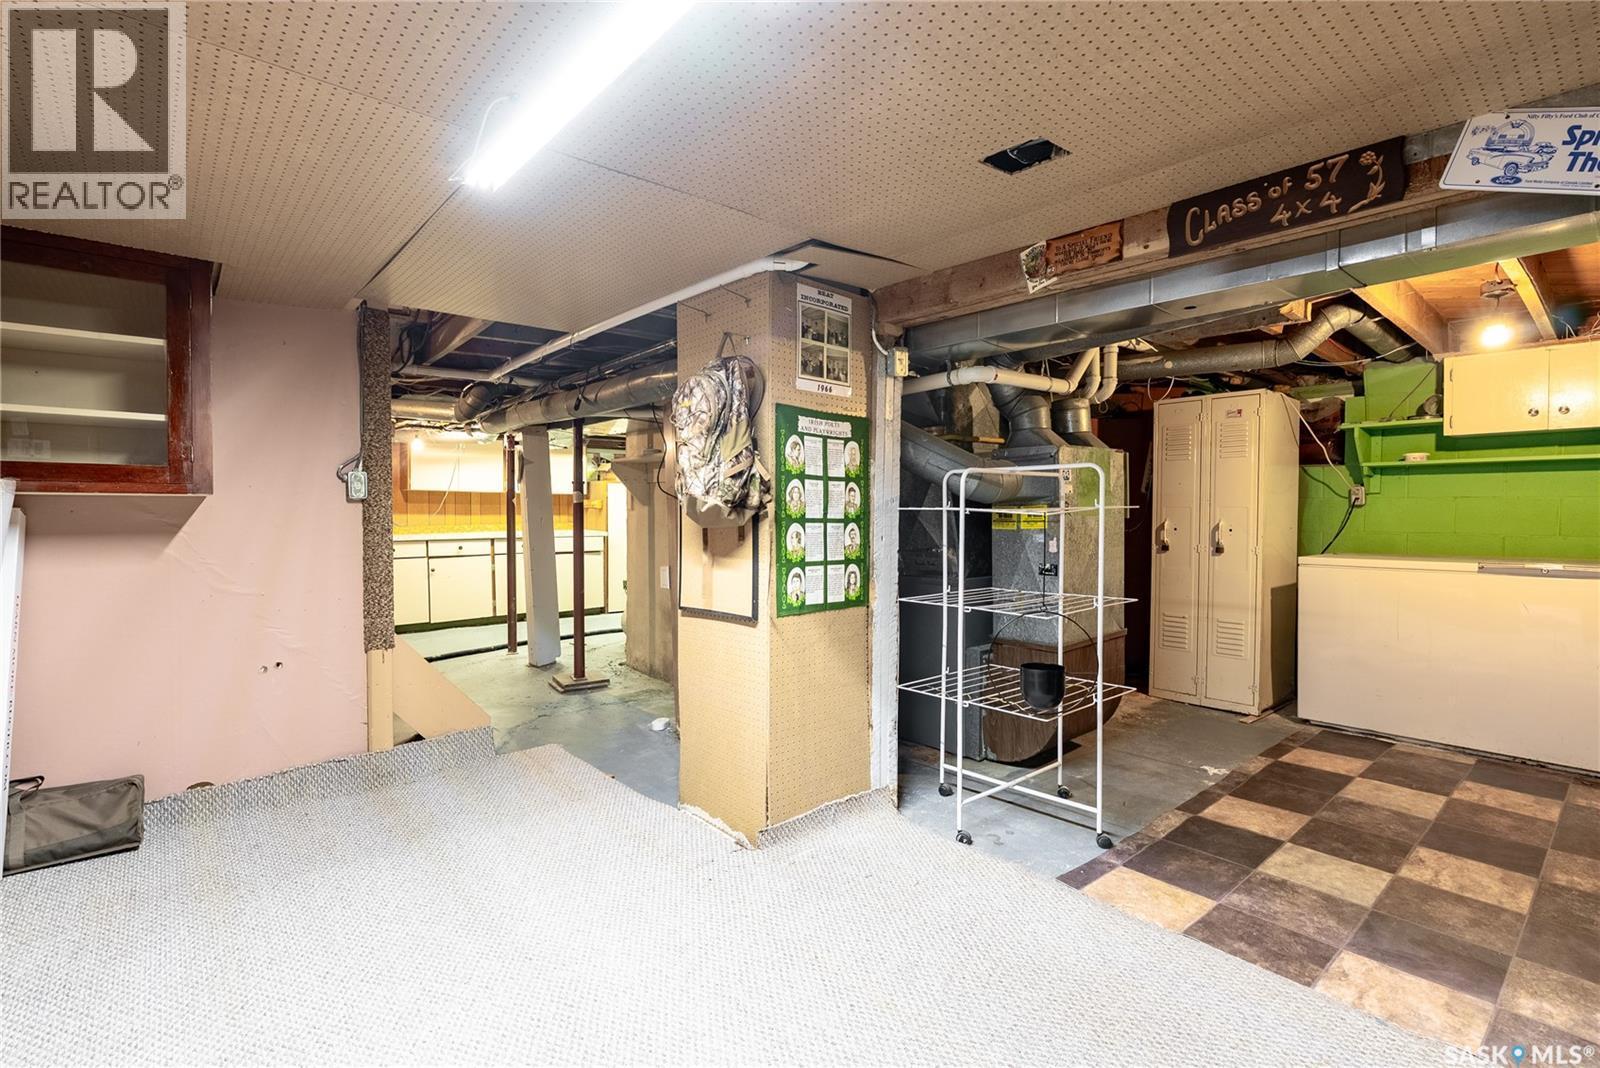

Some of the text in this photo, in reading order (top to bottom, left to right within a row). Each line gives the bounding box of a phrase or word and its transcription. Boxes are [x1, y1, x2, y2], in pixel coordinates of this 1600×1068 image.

[1268, 176, 1293, 199] of
[1304, 154, 1349, 190] 57
[800, 294, 848, 312] INCORPORATED
[817, 384, 832, 393] 1966
[813, 428, 848, 436] PLAYWRIGHTS
